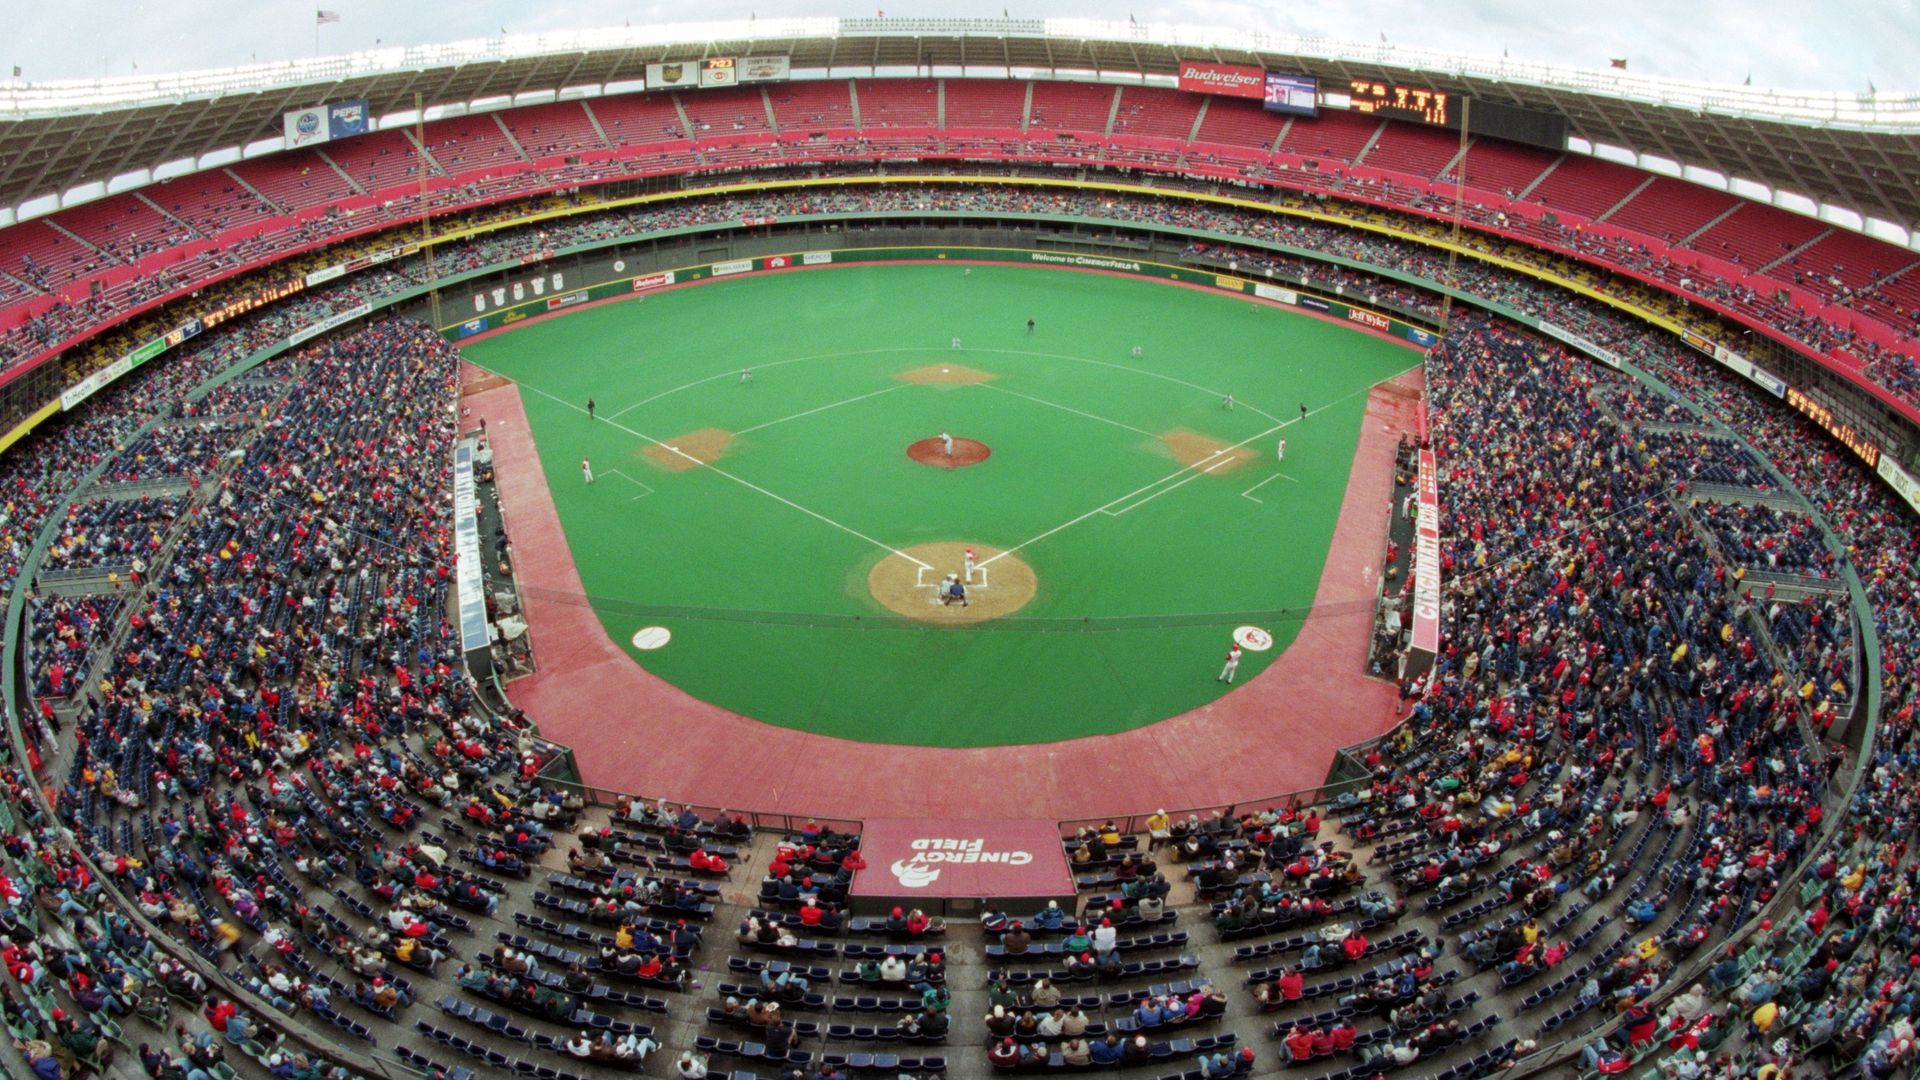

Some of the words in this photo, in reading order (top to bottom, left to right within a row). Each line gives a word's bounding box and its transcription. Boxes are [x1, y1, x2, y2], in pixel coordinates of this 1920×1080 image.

[709, 59, 733, 68] 7:23
[1183, 67, 1261, 85] Budweiser
[332, 105, 362, 119] PEPSI
[1032, 253, 1066, 264] Welcome
[1351, 308, 1366, 321] Jeff
[1366, 313, 1388, 329] Wyler
[1419, 502, 1437, 529] REDS
[1416, 535, 1438, 620] CINCINNATI
[911, 838, 984, 852] FIELD
[910, 851, 1033, 865] CINERGY
